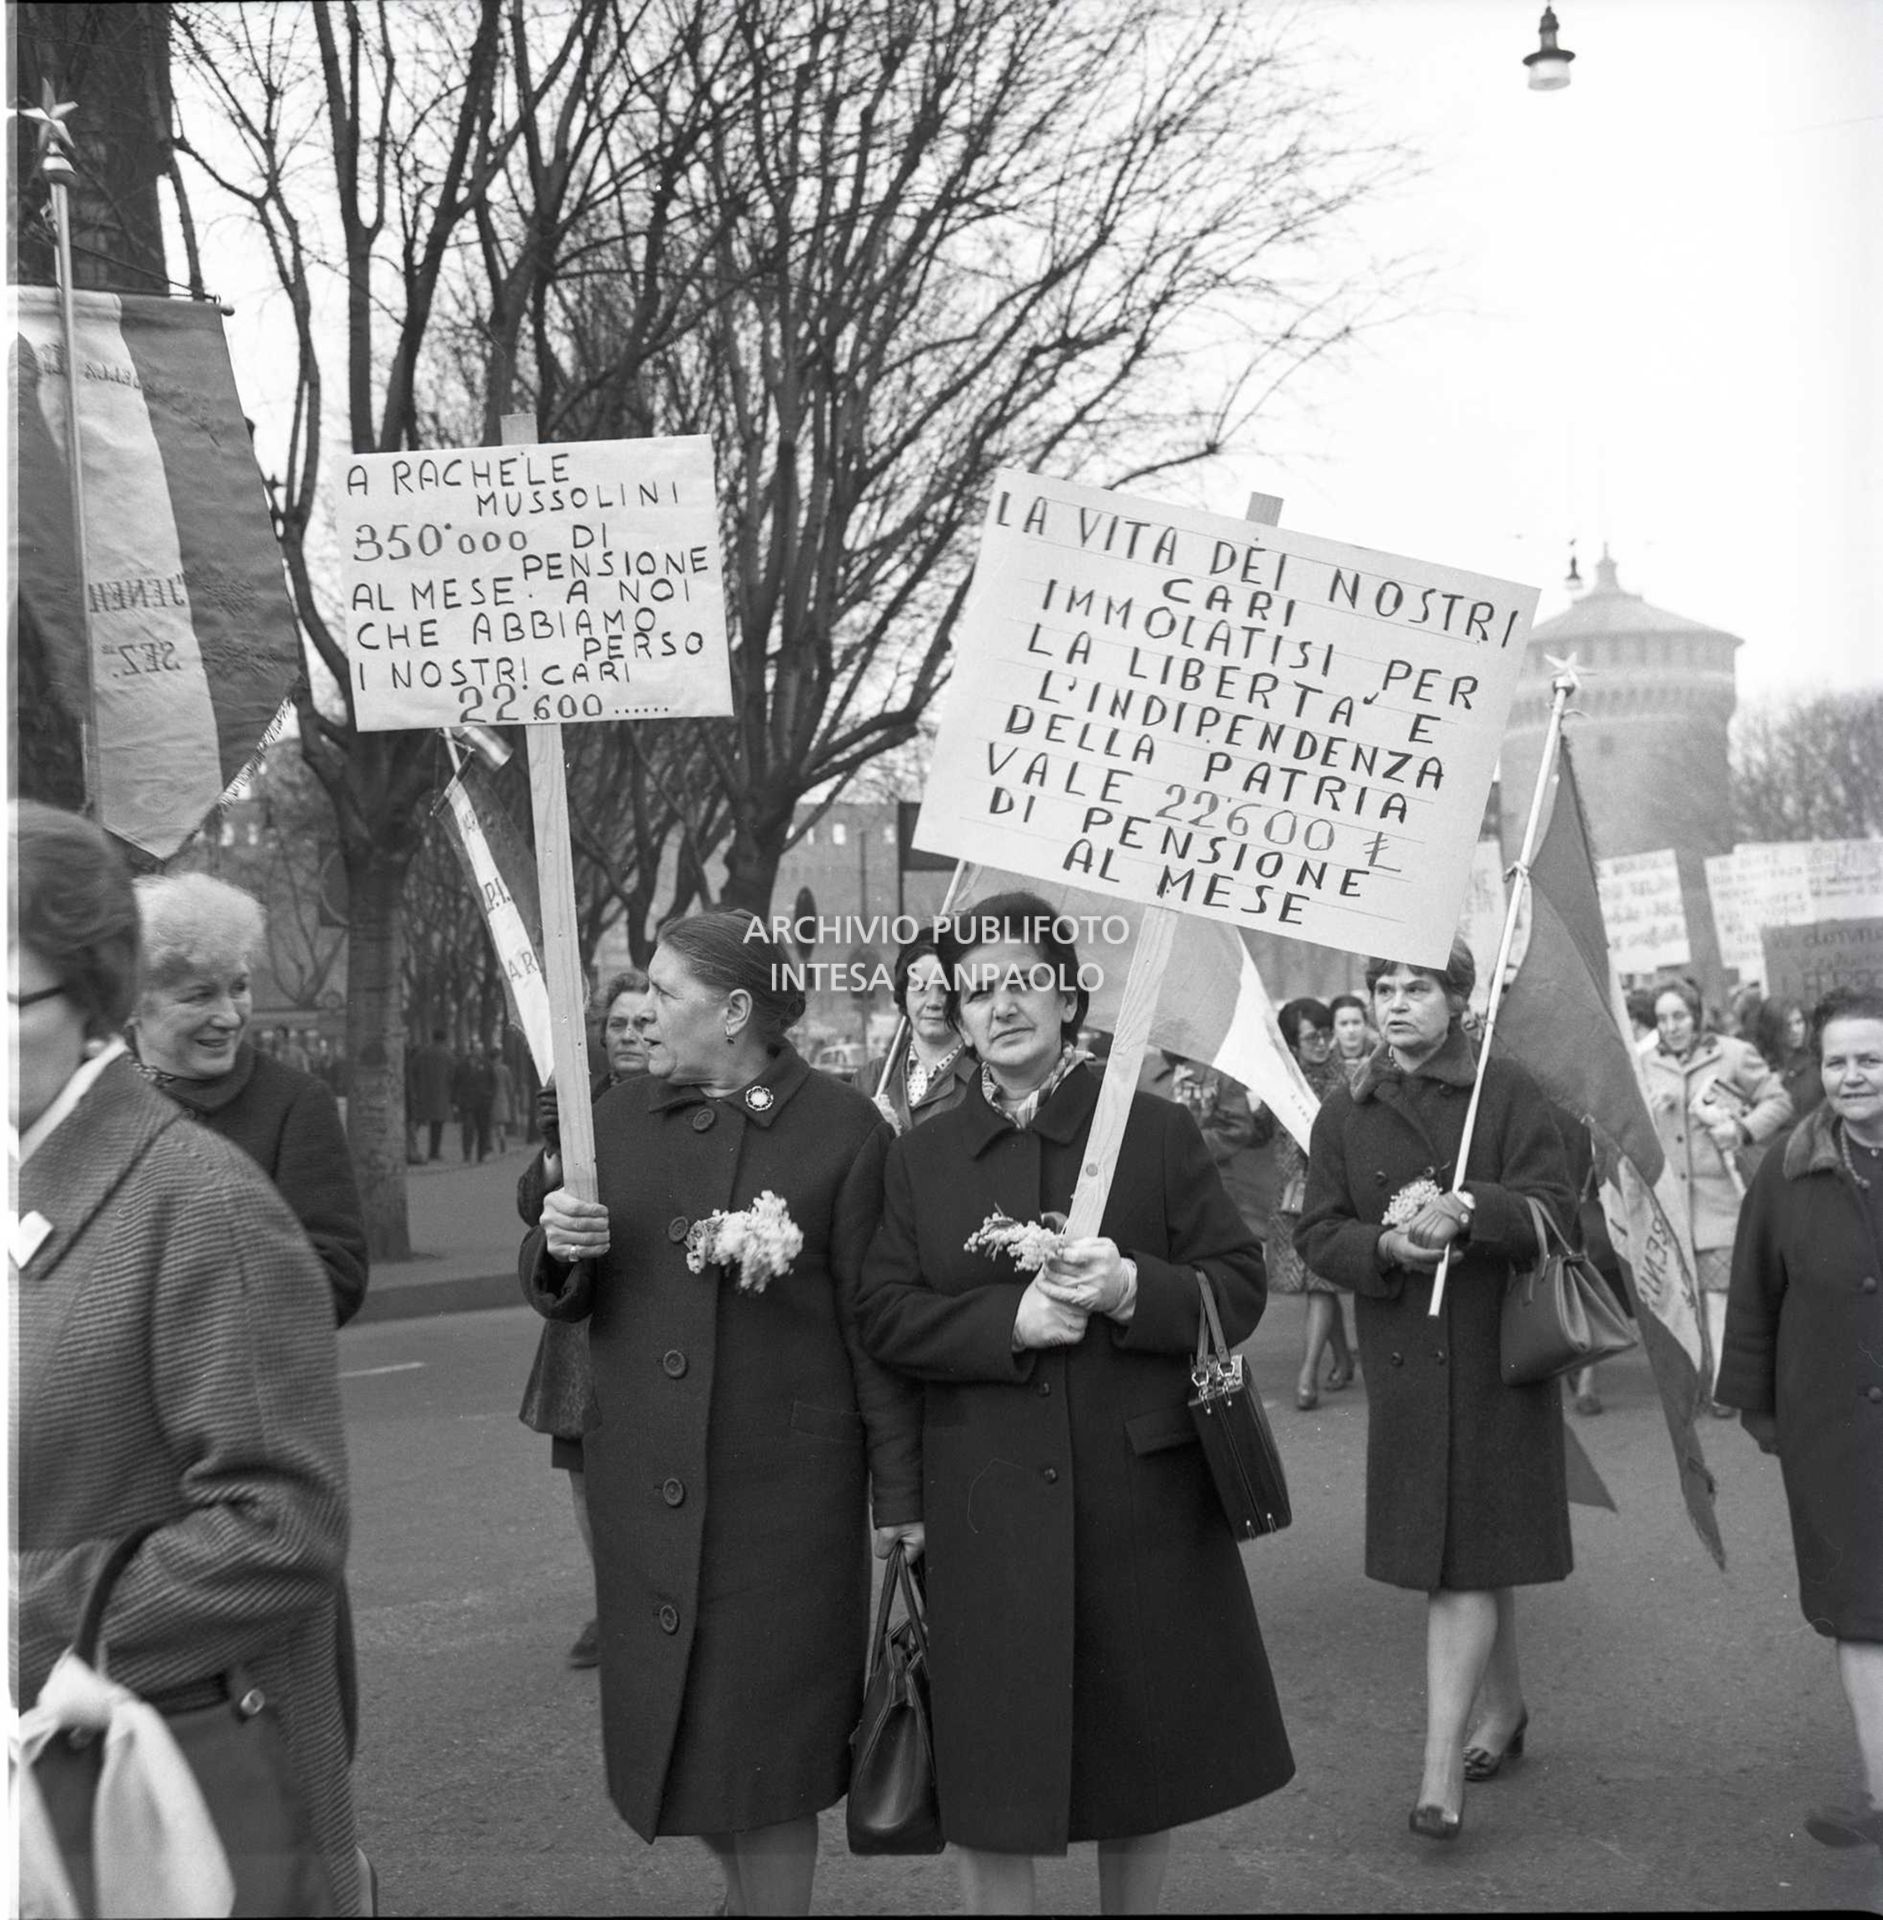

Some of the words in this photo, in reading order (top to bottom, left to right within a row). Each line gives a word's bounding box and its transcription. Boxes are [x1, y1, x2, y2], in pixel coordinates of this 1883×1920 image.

[348, 465, 368, 495] A
[393, 454, 568, 495] RACHELE
[477, 483, 678, 517] MUSSOLINI
[522, 546, 709, 580] PENSIONE
[573, 523, 606, 549] DI
[353, 584, 394, 611] AL
[567, 580, 588, 604] A
[619, 577, 690, 604] NOI
[997, 491, 1045, 534] LA
[1080, 507, 1177, 565] VITA
[1210, 541, 1287, 590] DEI
[1329, 568, 1519, 648] NOSTRI
[357, 619, 439, 650] CHE
[474, 607, 656, 644] ABBIAMO
[1160, 579, 1296, 627] CARI
[584, 632, 704, 662] PERSO
[1042, 579, 1334, 677] IMMOLATISI
[1383, 659, 1479, 710] PER
[359, 662, 366, 691] I
[542, 661, 630, 686] CARI
[1028, 623, 1091, 665] LA
[1409, 714, 1441, 744] E
[1005, 704, 1154, 765] DELLA
[1039, 670, 1445, 791] L'INDIPENDENZA
[989, 742, 1133, 804] VALE
[1203, 751, 1407, 824] PATRIA
[990, 787, 1036, 823] DI
[1082, 807, 1371, 897] PENSIONE
[1063, 839, 1120, 882] AL
[1157, 864, 1310, 925] MESE
